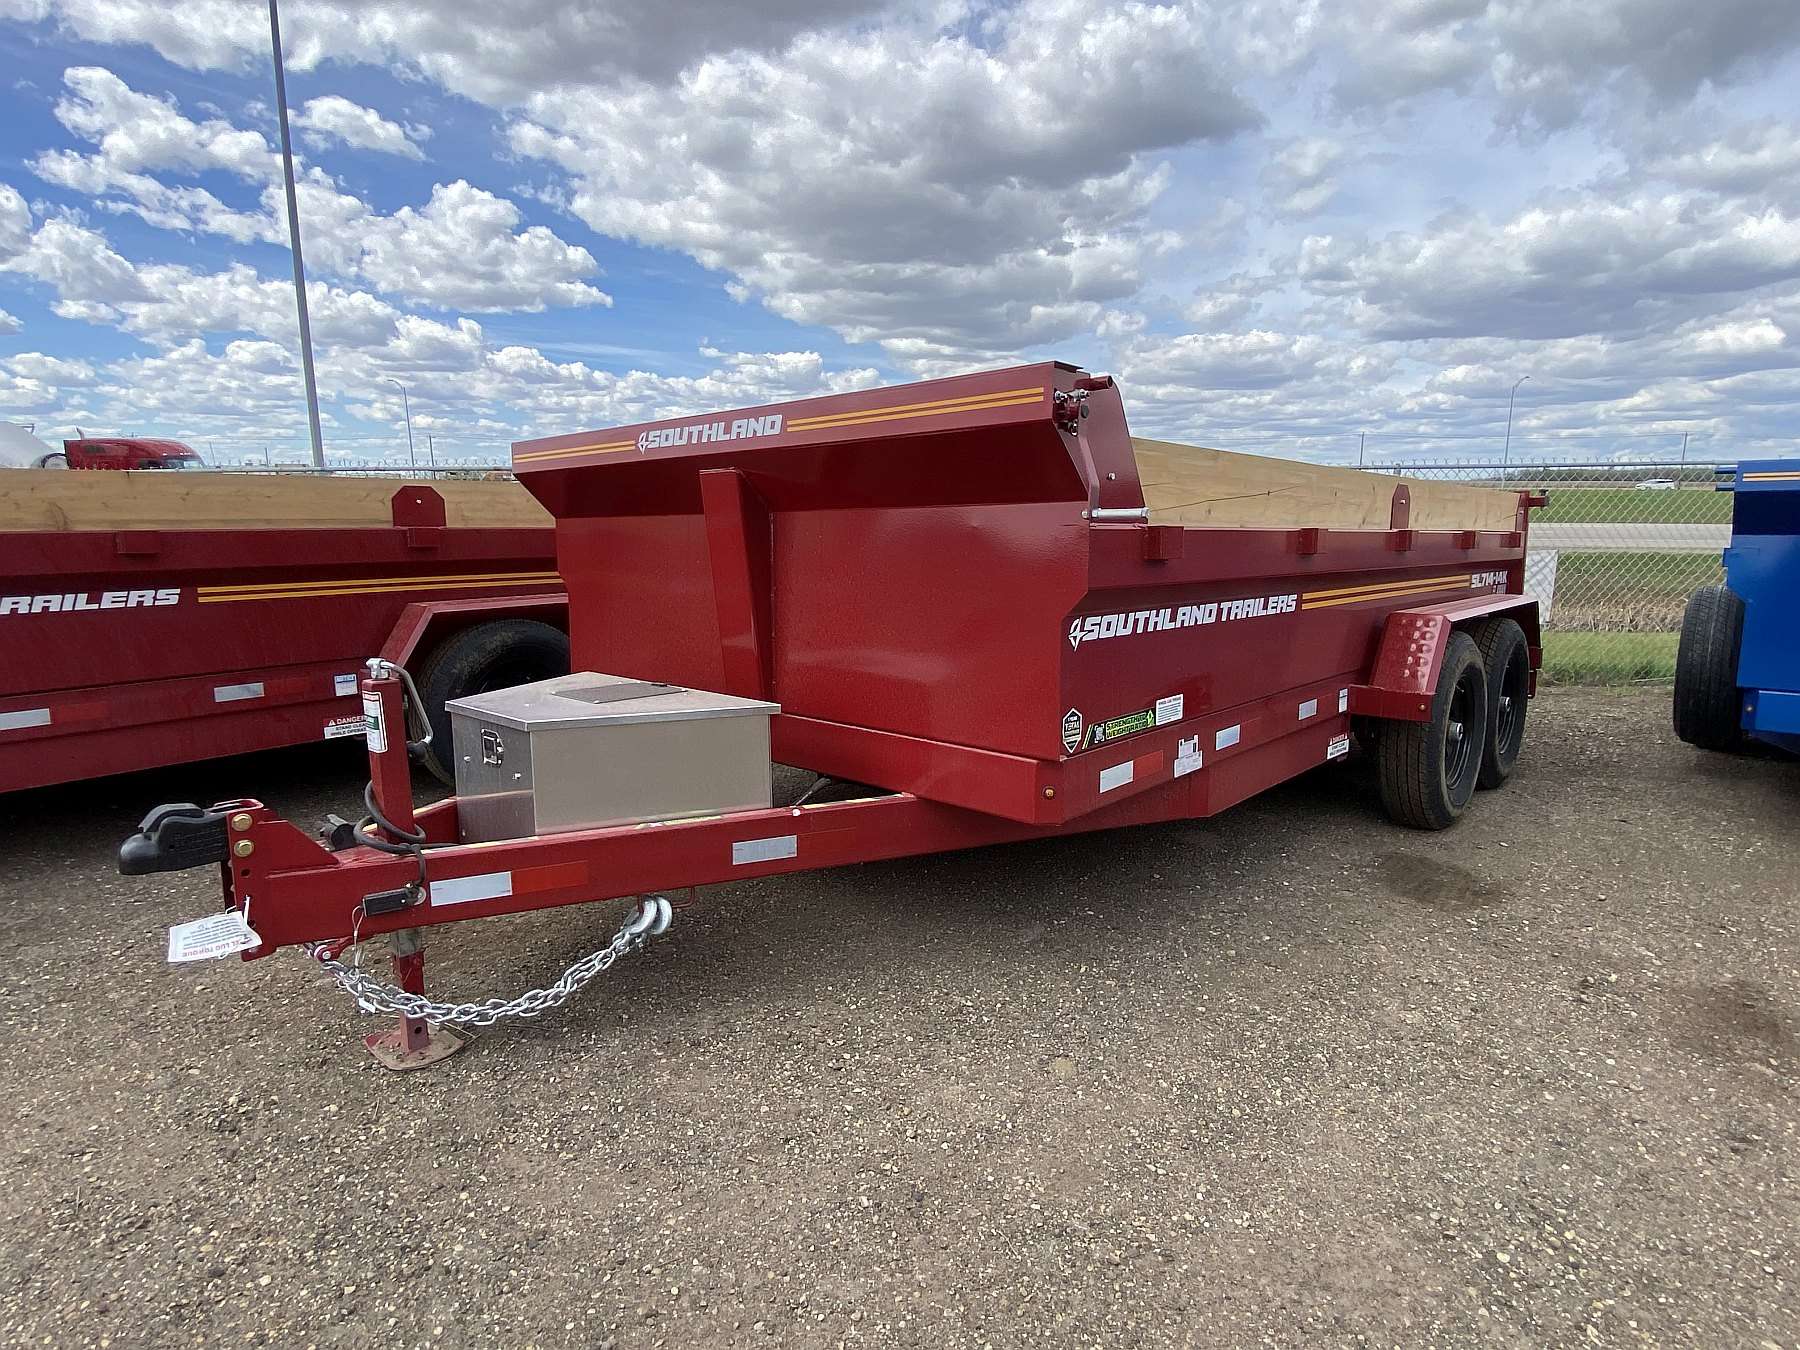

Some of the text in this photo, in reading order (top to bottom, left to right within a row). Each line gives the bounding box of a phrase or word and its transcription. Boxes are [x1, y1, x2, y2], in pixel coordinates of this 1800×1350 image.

[647, 414, 783, 449] SOUTHLAND
[0, 588, 181, 615] RAILERS
[1081, 594, 1298, 642] SOUTHLAND TRAILERS
